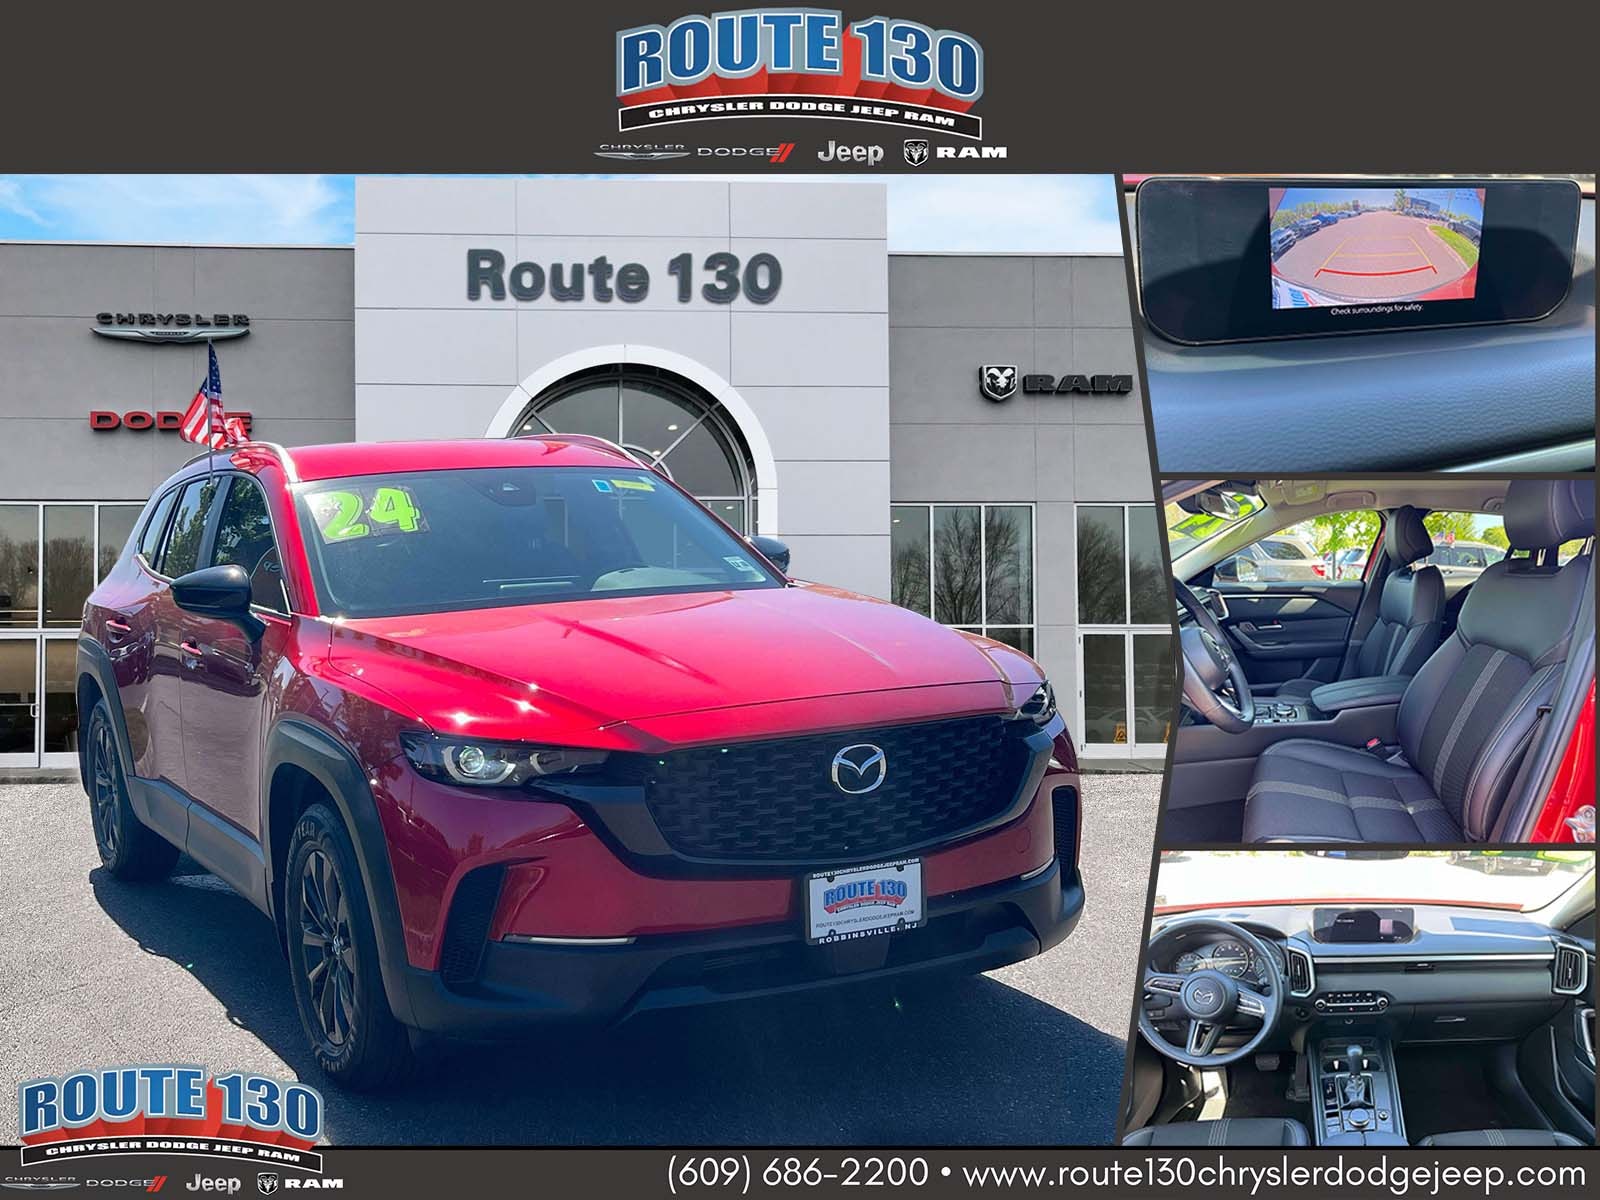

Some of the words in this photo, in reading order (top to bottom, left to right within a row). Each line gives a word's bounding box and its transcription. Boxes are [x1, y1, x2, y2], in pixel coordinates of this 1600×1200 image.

[466, 248, 651, 303] Route
[667, 252, 783, 305] 130
[96, 312, 250, 326] CHRYSLER
[1330, 307, 1351, 315] Check
[1352, 303, 1393, 314] surroundings
[1393, 303, 1402, 312] for
[1022, 374, 1133, 394] RAM
[322, 487, 420, 540] 24
[824, 880, 876, 906] ROUTE
[878, 880, 907, 897] 130
[818, 925, 901, 945] ROBBINSVILLE,
[904, 922, 918, 930] NJ
